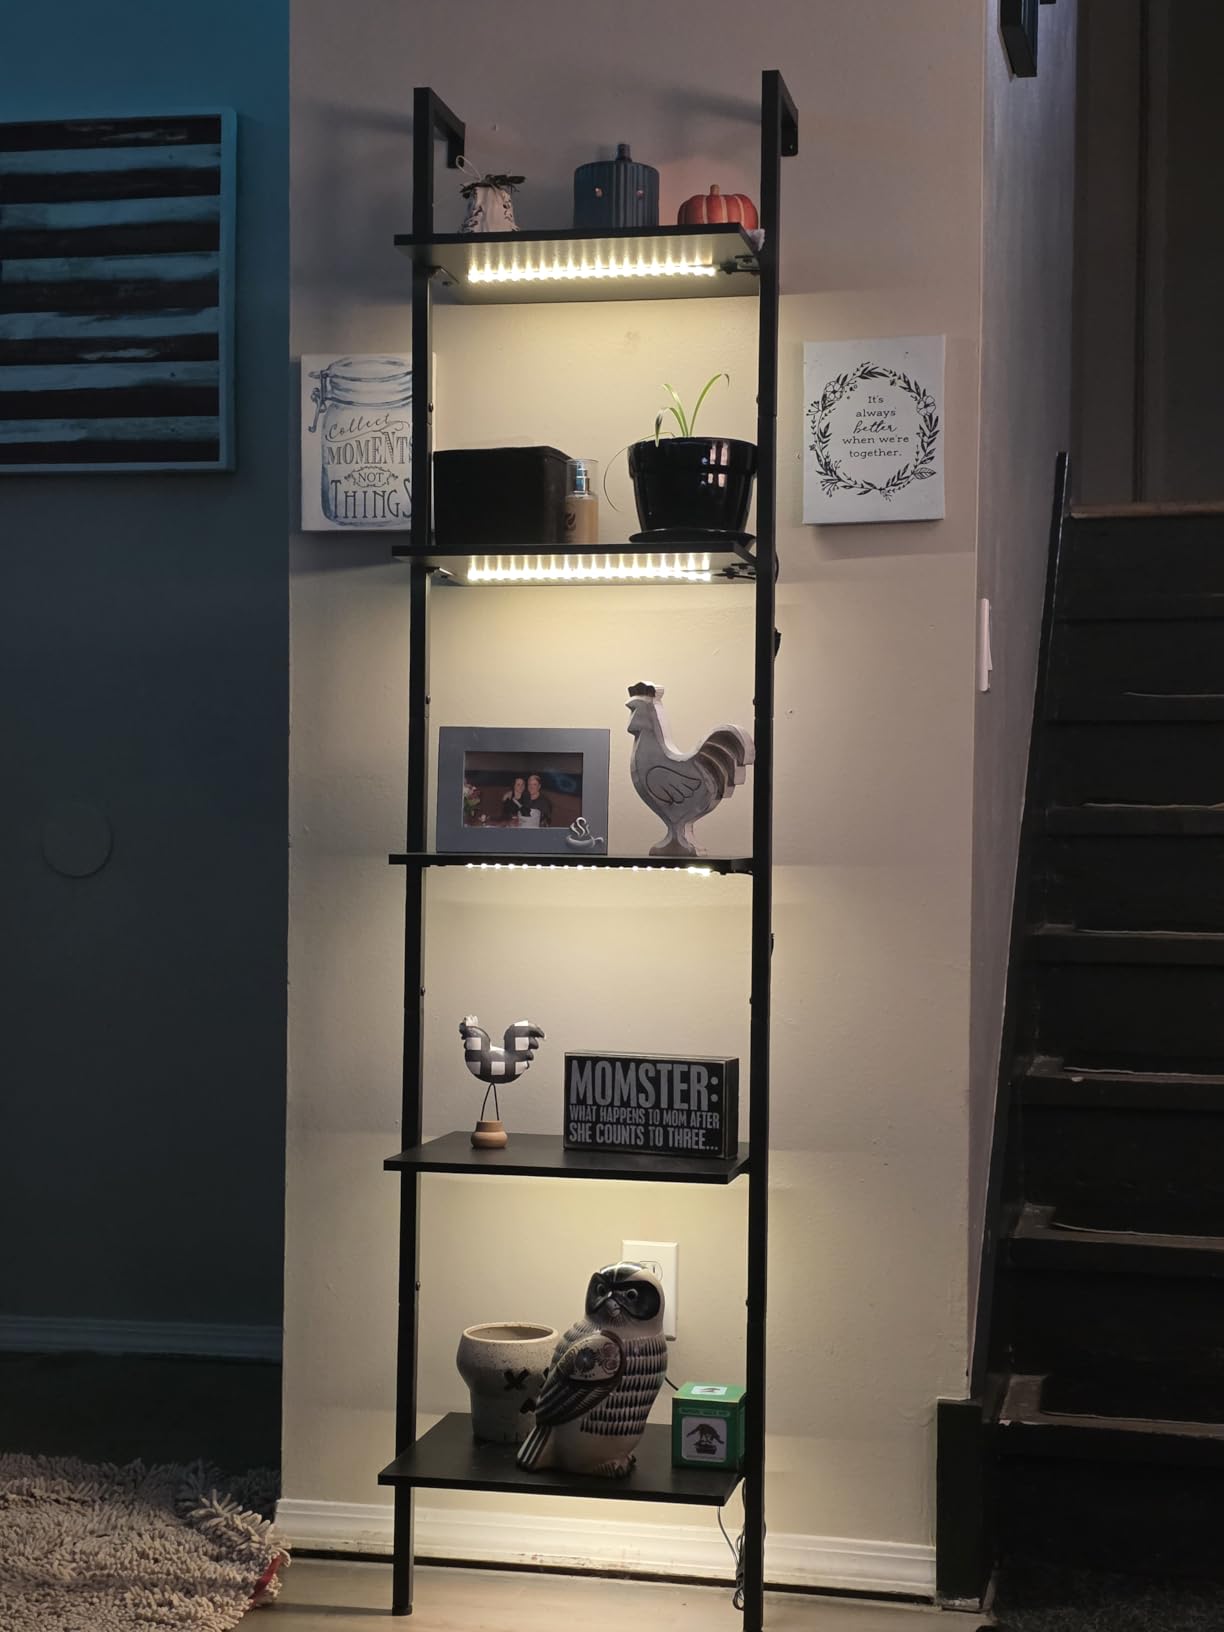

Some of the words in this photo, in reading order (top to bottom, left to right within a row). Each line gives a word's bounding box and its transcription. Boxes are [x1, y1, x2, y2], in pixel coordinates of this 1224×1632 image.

[868, 395, 884, 404] It's
[856, 409, 896, 418] always
[326, 413, 398, 441] Collect
[853, 420, 897, 434] better
[842, 436, 875, 444] when
[879, 435, 909, 443] we're
[327, 432, 412, 465] MOMENT
[850, 448, 902, 460] together.
[358, 472, 385, 482] NOT
[570, 1060, 719, 1111] MOMSTER:
[569, 1105, 597, 1122] WHAT
[600, 1106, 646, 1125] HAPPENS
[648, 1109, 660, 1125] TO
[663, 1110, 687, 1127] MOM
[690, 1111, 720, 1129] AFTER
[569, 1122, 592, 1143] SHE
[596, 1123, 645, 1146] COUNTS
[648, 1126, 664, 1147] TO
[667, 1127, 719, 1150] THREE...
